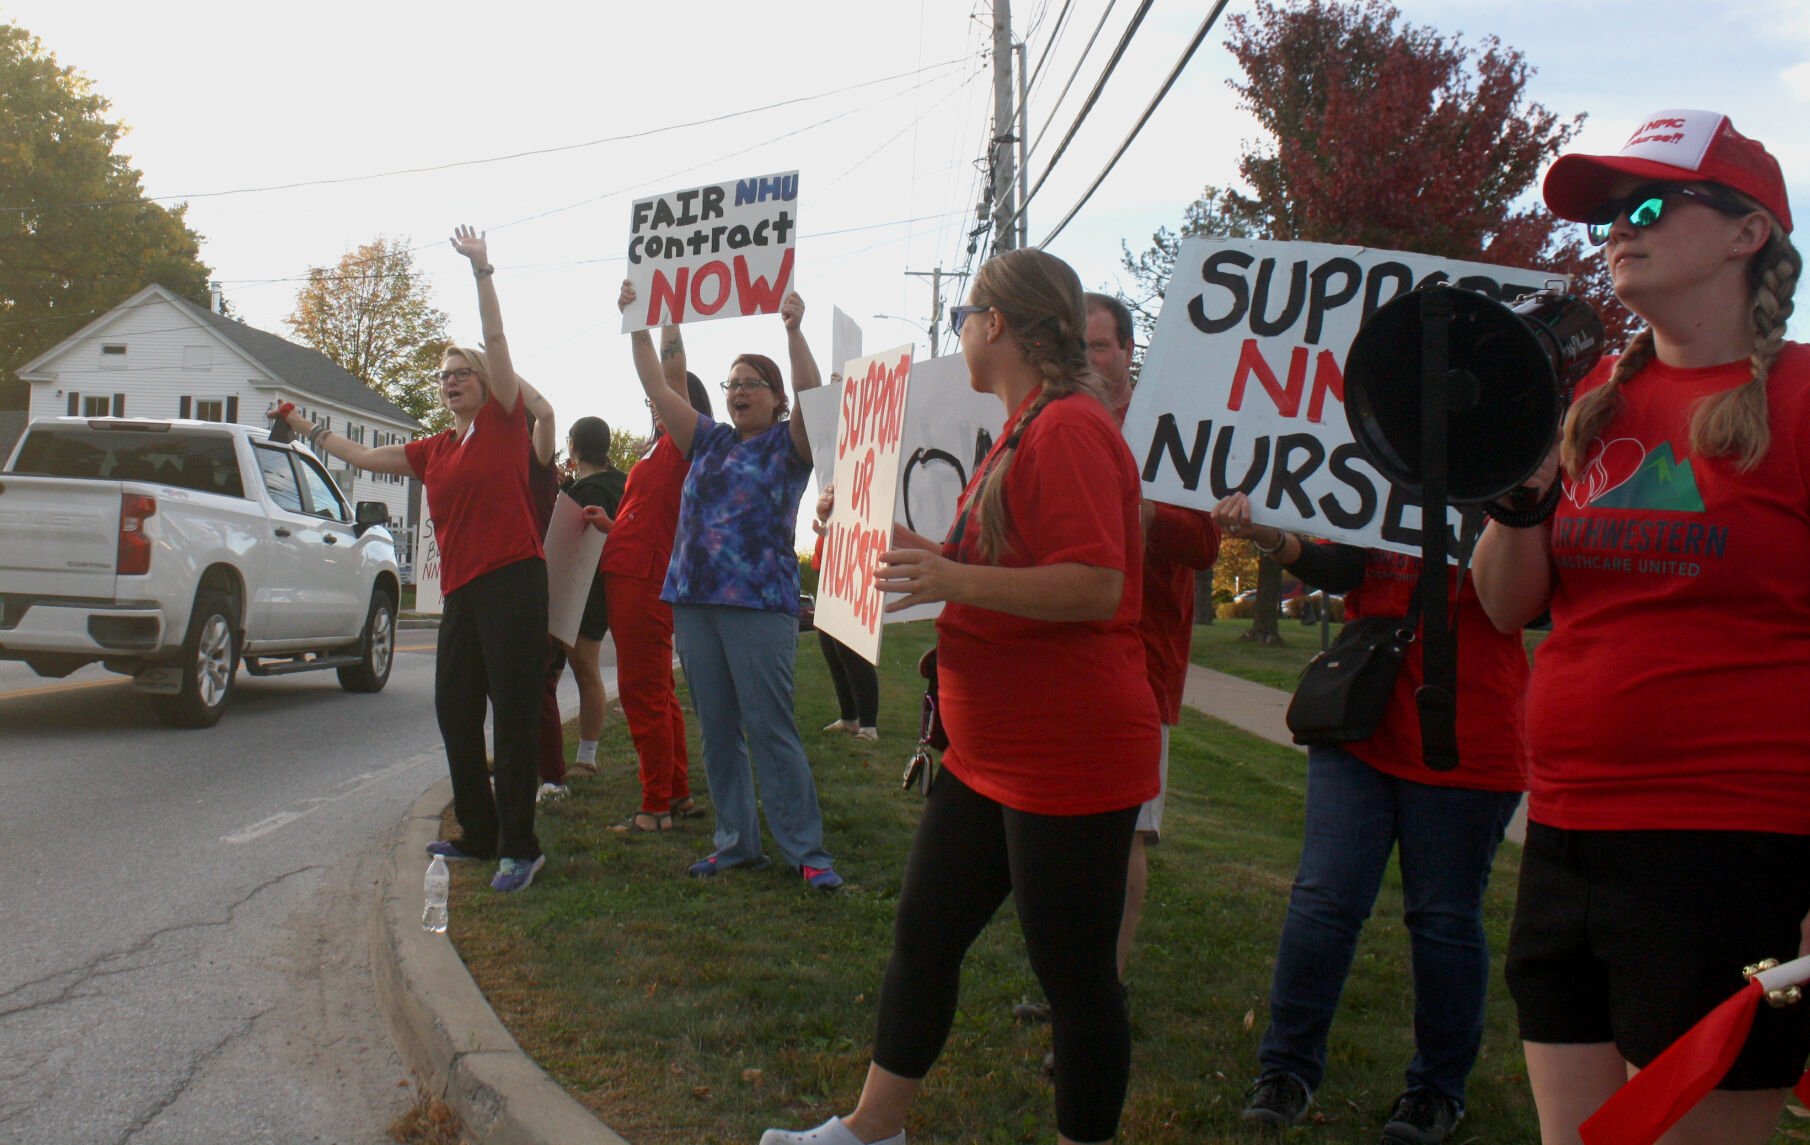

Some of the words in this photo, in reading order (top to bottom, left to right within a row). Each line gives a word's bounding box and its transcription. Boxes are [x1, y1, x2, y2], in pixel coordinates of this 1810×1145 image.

[632, 186, 725, 234] FAIR
[735, 174, 799, 207] NHU
[646, 247, 795, 326] NOW
[1188, 250, 1546, 344] SUPP
[839, 354, 911, 460] SUPPORT
[851, 447, 874, 524] UR
[1142, 413, 1470, 559] NURSE
[822, 521, 887, 635] NURSES
[1639, 560, 1701, 577] UNITED
